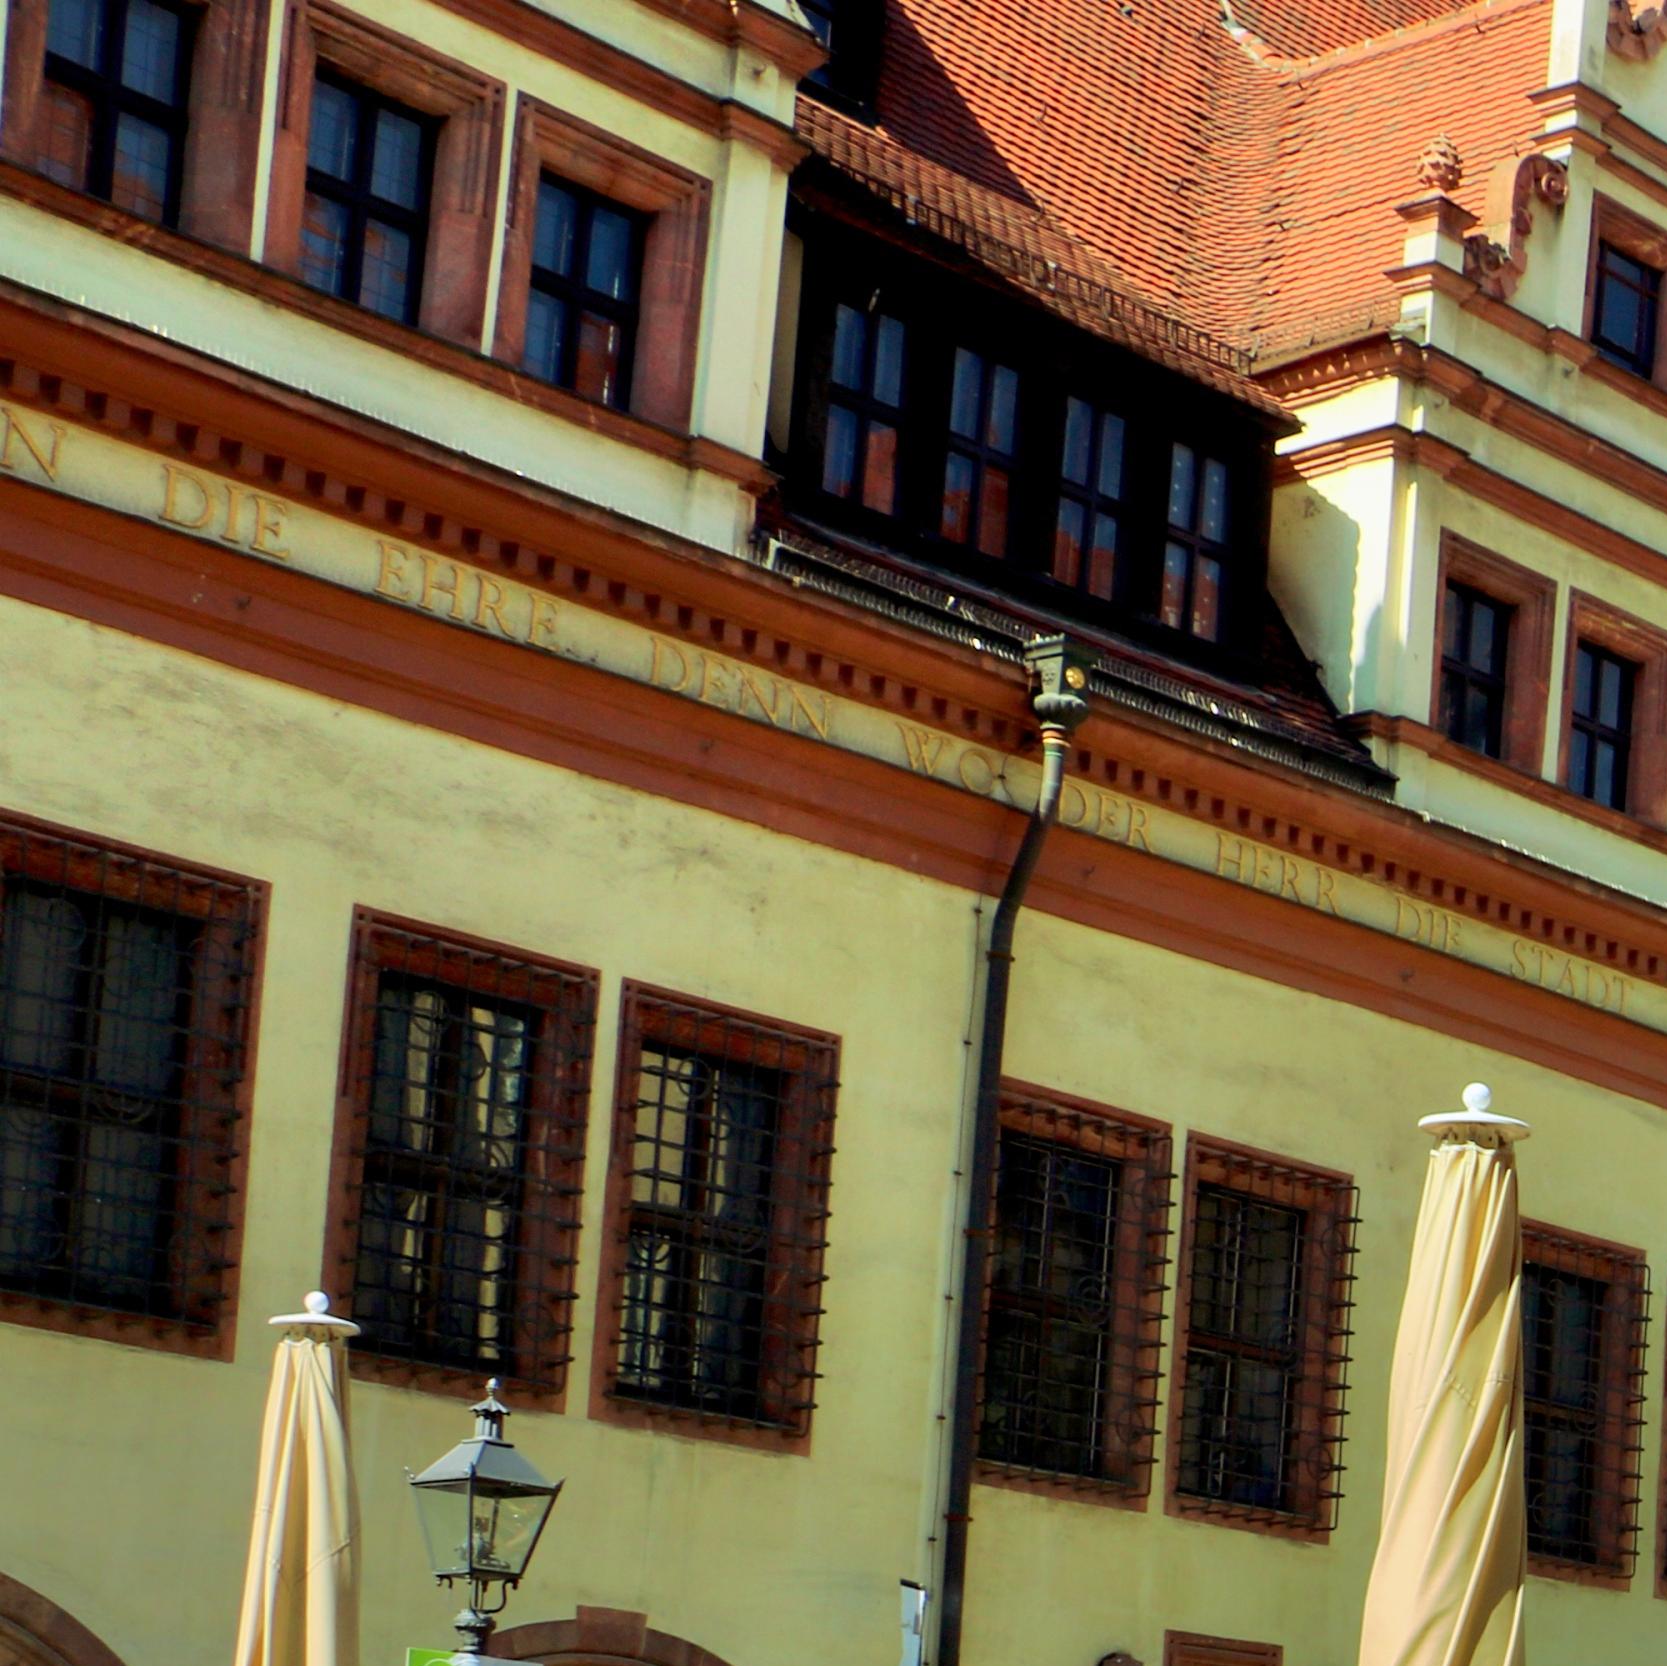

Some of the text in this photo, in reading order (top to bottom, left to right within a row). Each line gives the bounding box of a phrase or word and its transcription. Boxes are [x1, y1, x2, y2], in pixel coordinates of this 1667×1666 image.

[158, 463, 291, 562] DIE
[374, 539, 561, 653] EHRE
[650, 636, 832, 740] DENN
[896, 721, 995, 796] WO
[1058, 783, 1153, 852] DER
[1215, 831, 1343, 916] HERR
[1393, 896, 1464, 955] DIE
[1509, 938, 1636, 1018] STADT
